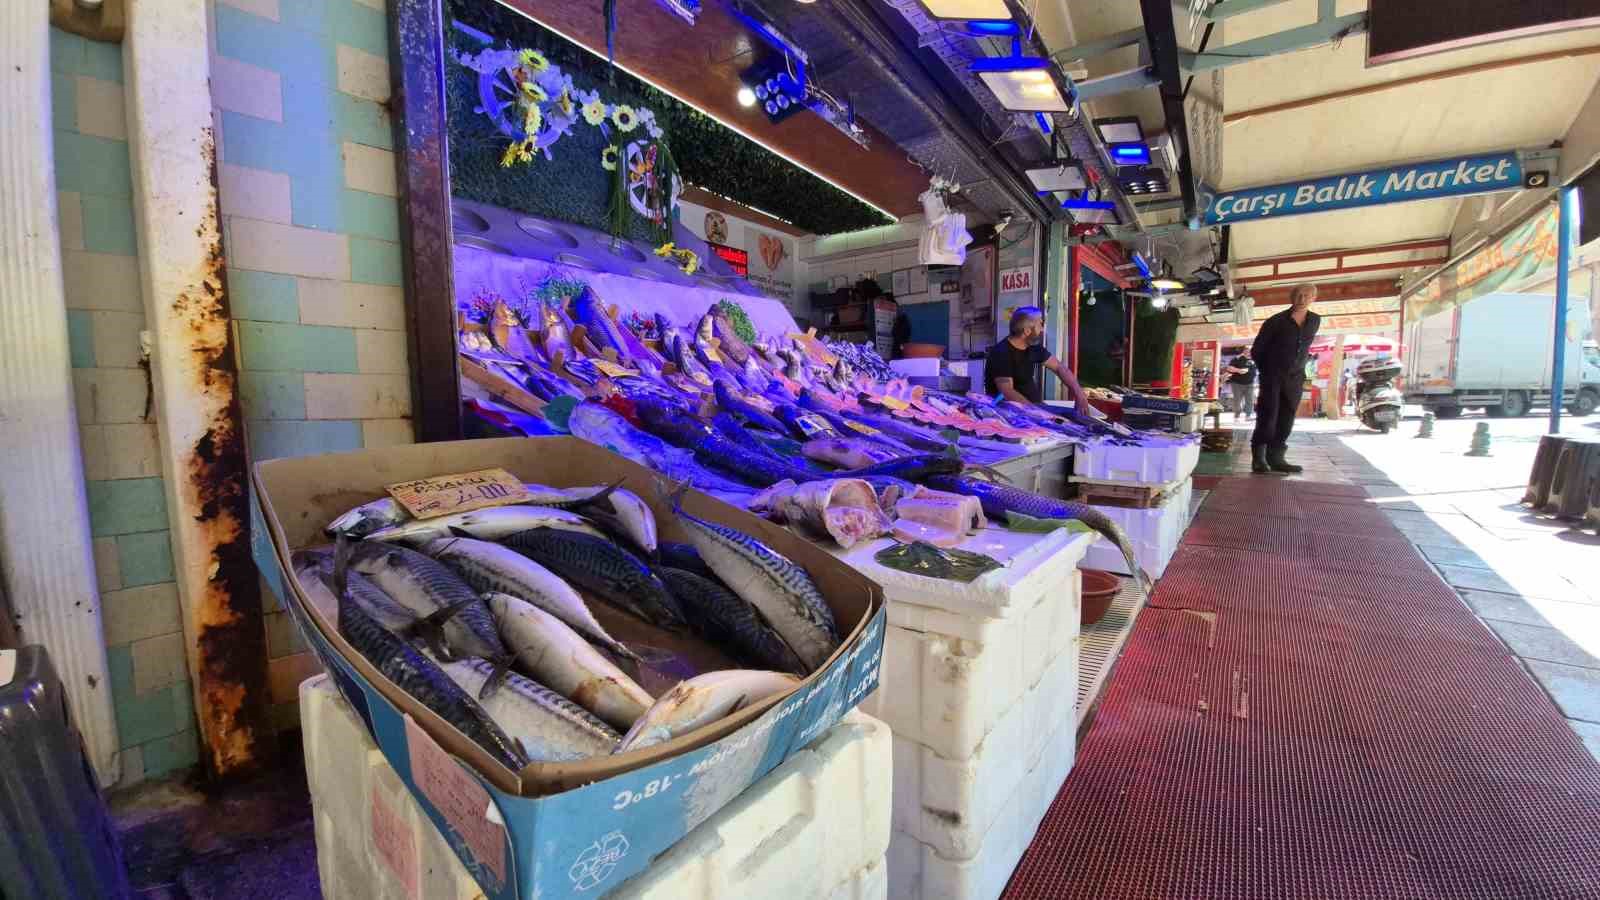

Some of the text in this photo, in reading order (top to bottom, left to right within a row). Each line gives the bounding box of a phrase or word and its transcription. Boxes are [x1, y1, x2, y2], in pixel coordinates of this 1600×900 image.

[1215, 159, 1511, 221] Çarşı Balık Market
[1002, 272, 1030, 290] KASA
